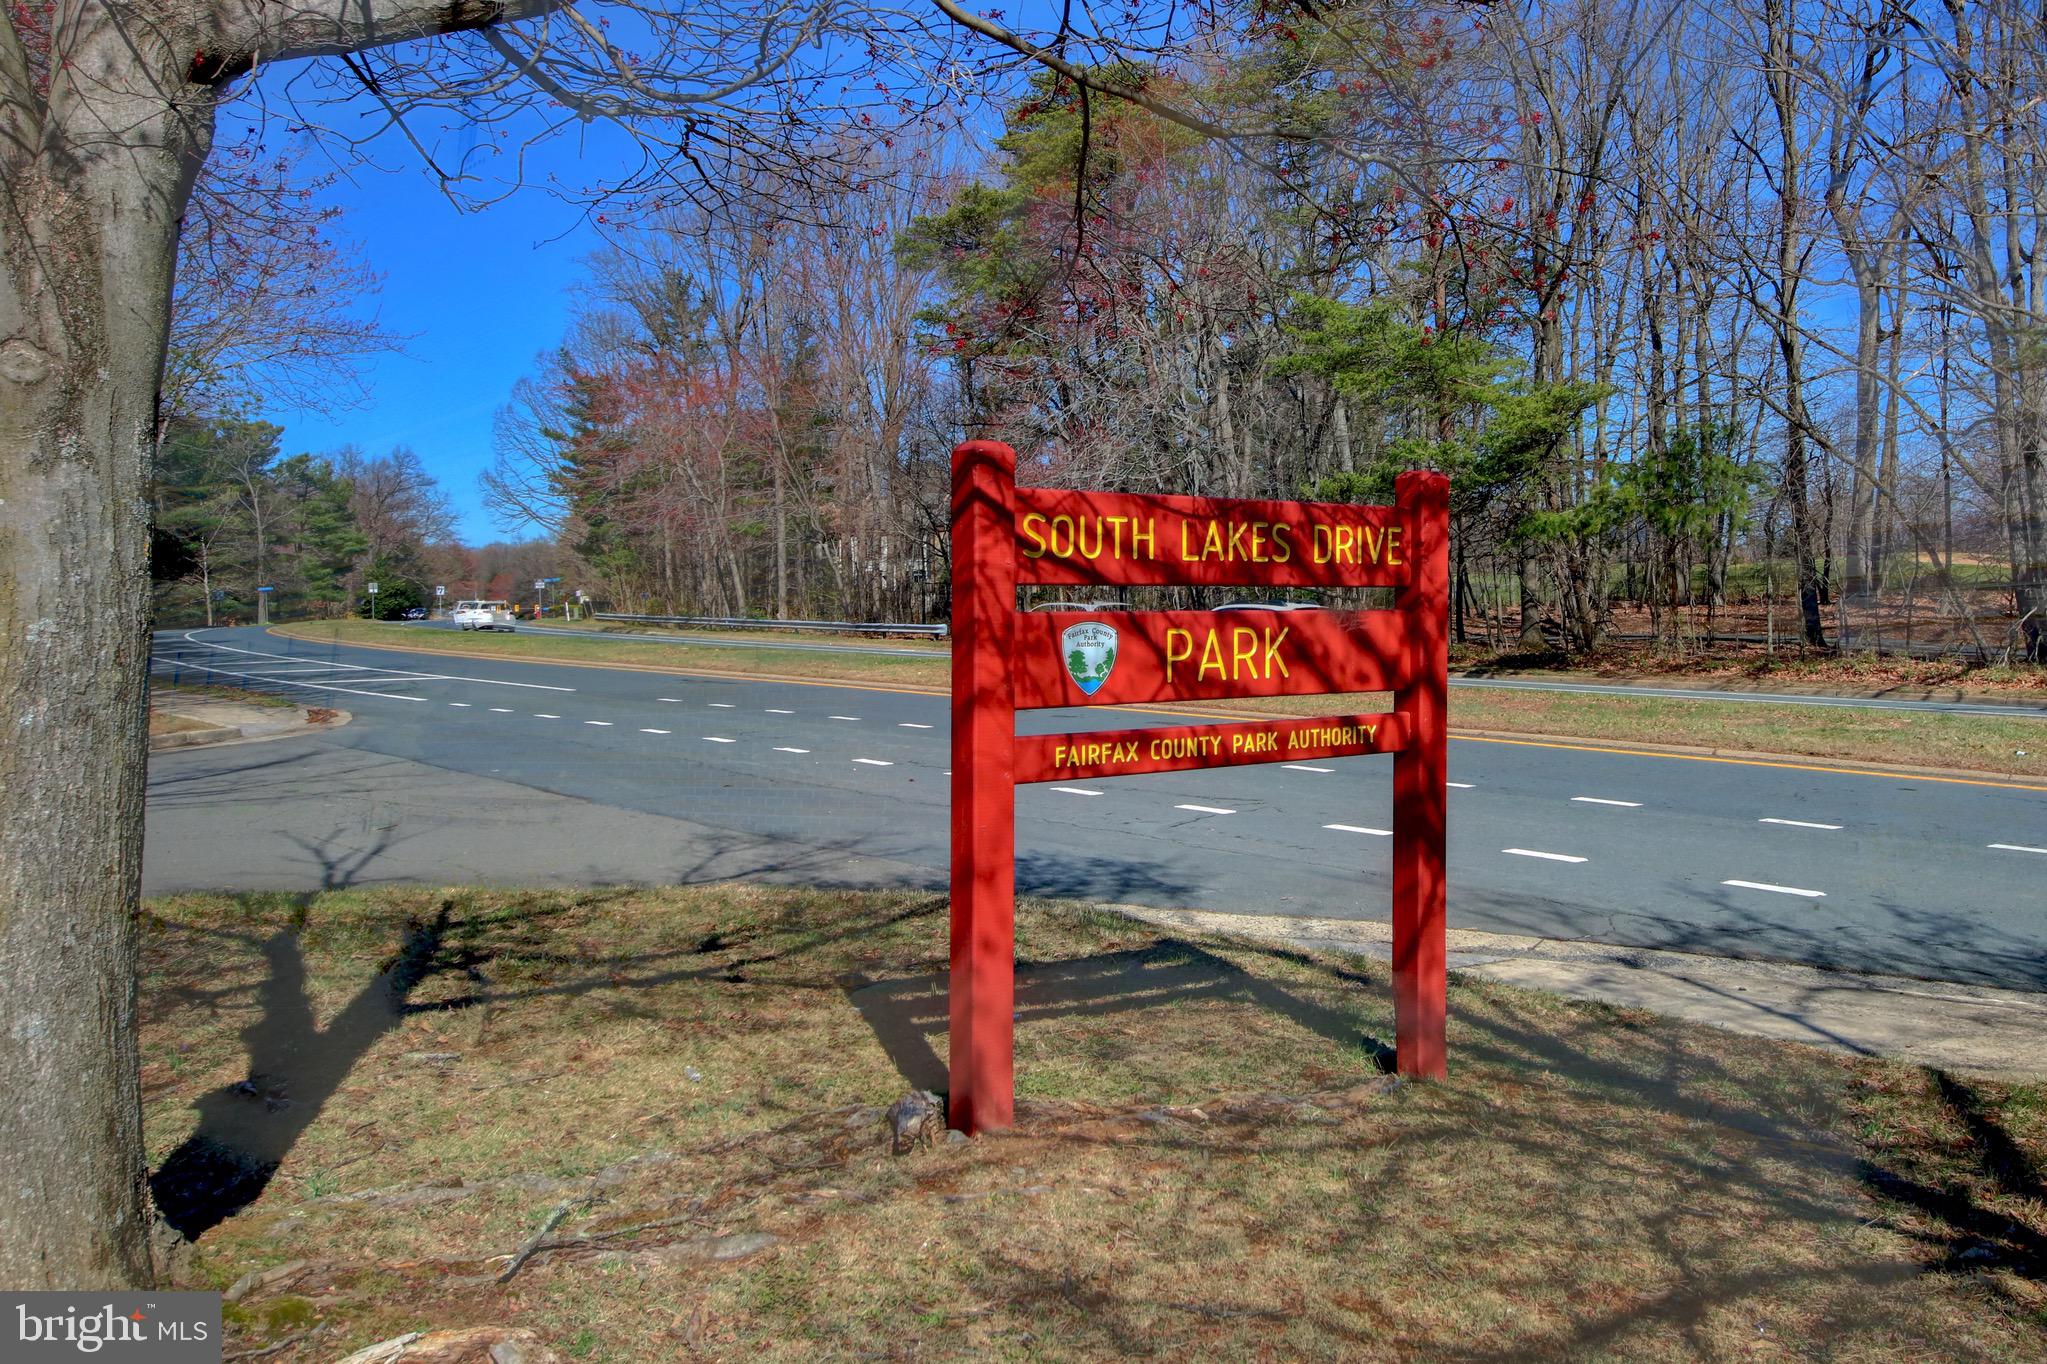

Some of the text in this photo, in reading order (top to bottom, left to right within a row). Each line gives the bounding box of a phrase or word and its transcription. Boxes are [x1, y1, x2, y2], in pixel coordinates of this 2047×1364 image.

[1022, 512, 1403, 565] SOUTH LAKES DRIVE
[1067, 628, 1113, 640] Fairfax County
[1166, 626, 1290, 684] PARK
[1055, 724, 1377, 768] FAIRFAX COUNTY PARK AUTHORITY
